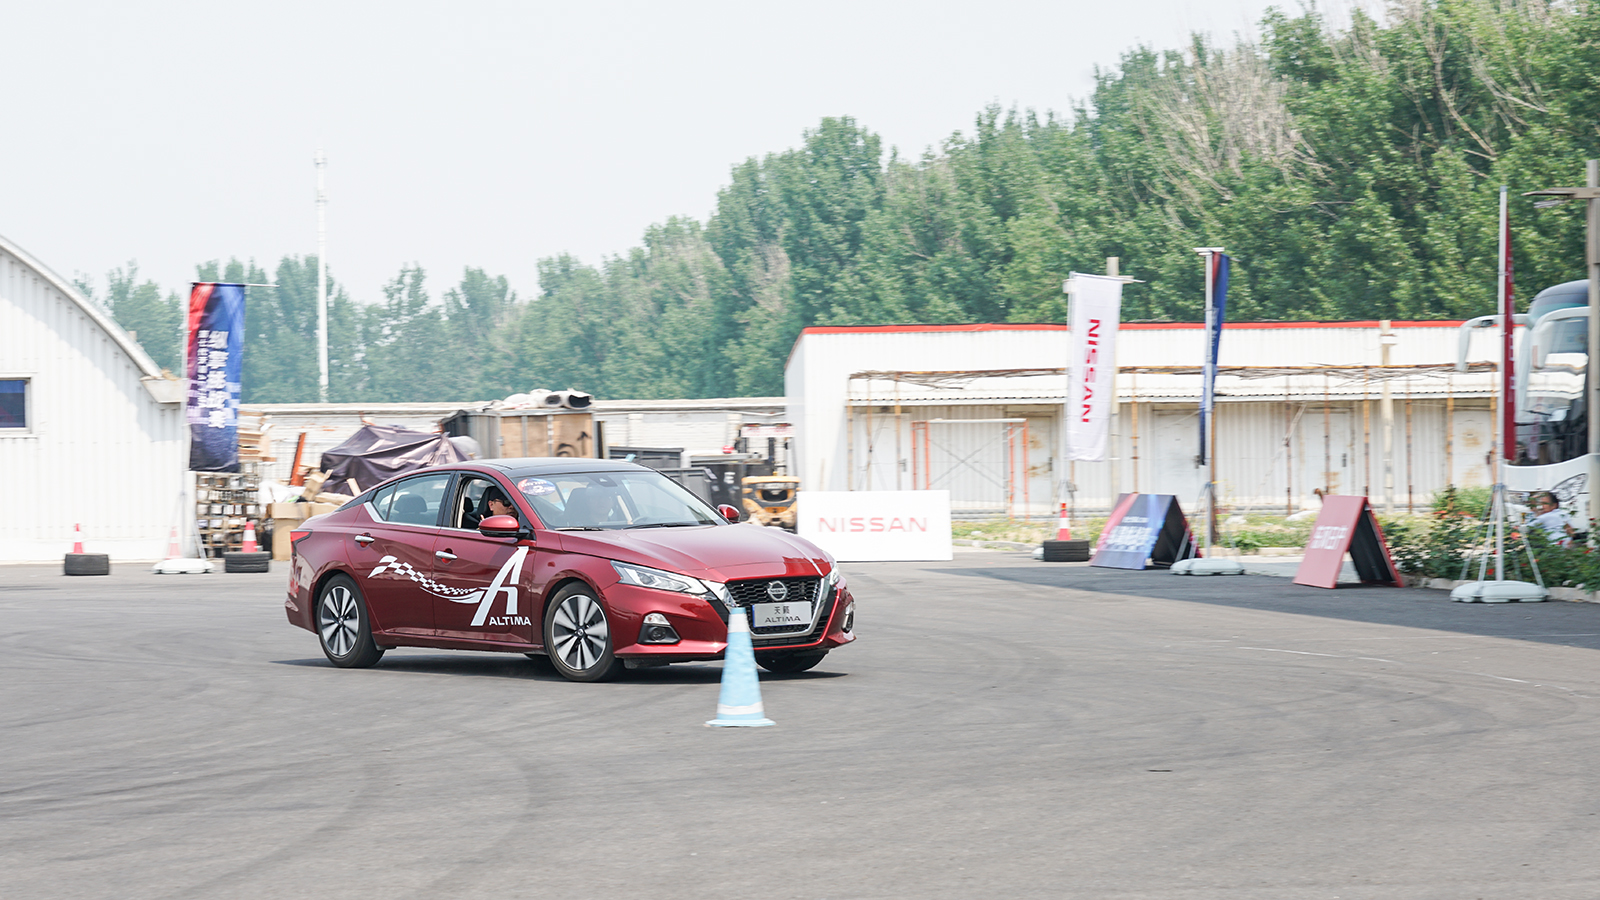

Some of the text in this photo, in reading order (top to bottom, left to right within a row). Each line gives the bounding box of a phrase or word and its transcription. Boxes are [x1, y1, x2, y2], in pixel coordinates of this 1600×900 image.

[1081, 319, 1101, 423] NISSAN
[818, 517, 927, 532] NISSAN
[489, 616, 532, 626] ALTIMA
